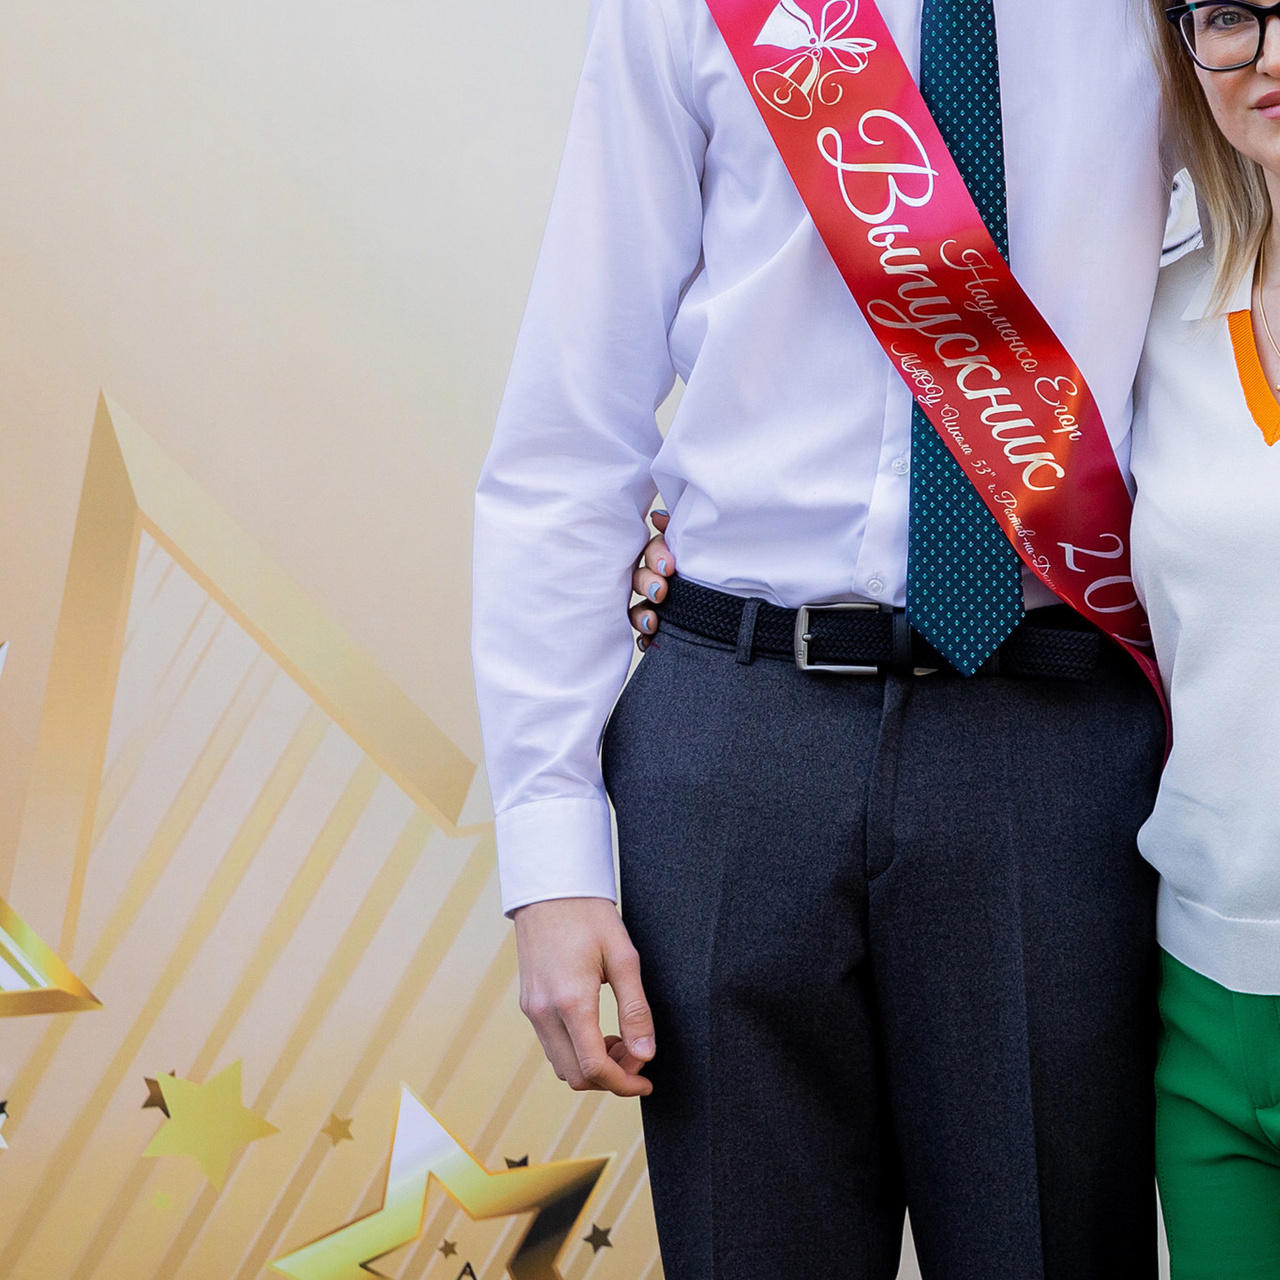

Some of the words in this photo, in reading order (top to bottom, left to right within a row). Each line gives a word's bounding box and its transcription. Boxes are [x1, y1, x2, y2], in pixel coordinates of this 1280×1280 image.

[816, 108, 1066, 492] Выпускник
[939, 238, 1039, 374] Науменко
[1033, 375, 1083, 441] Егор
